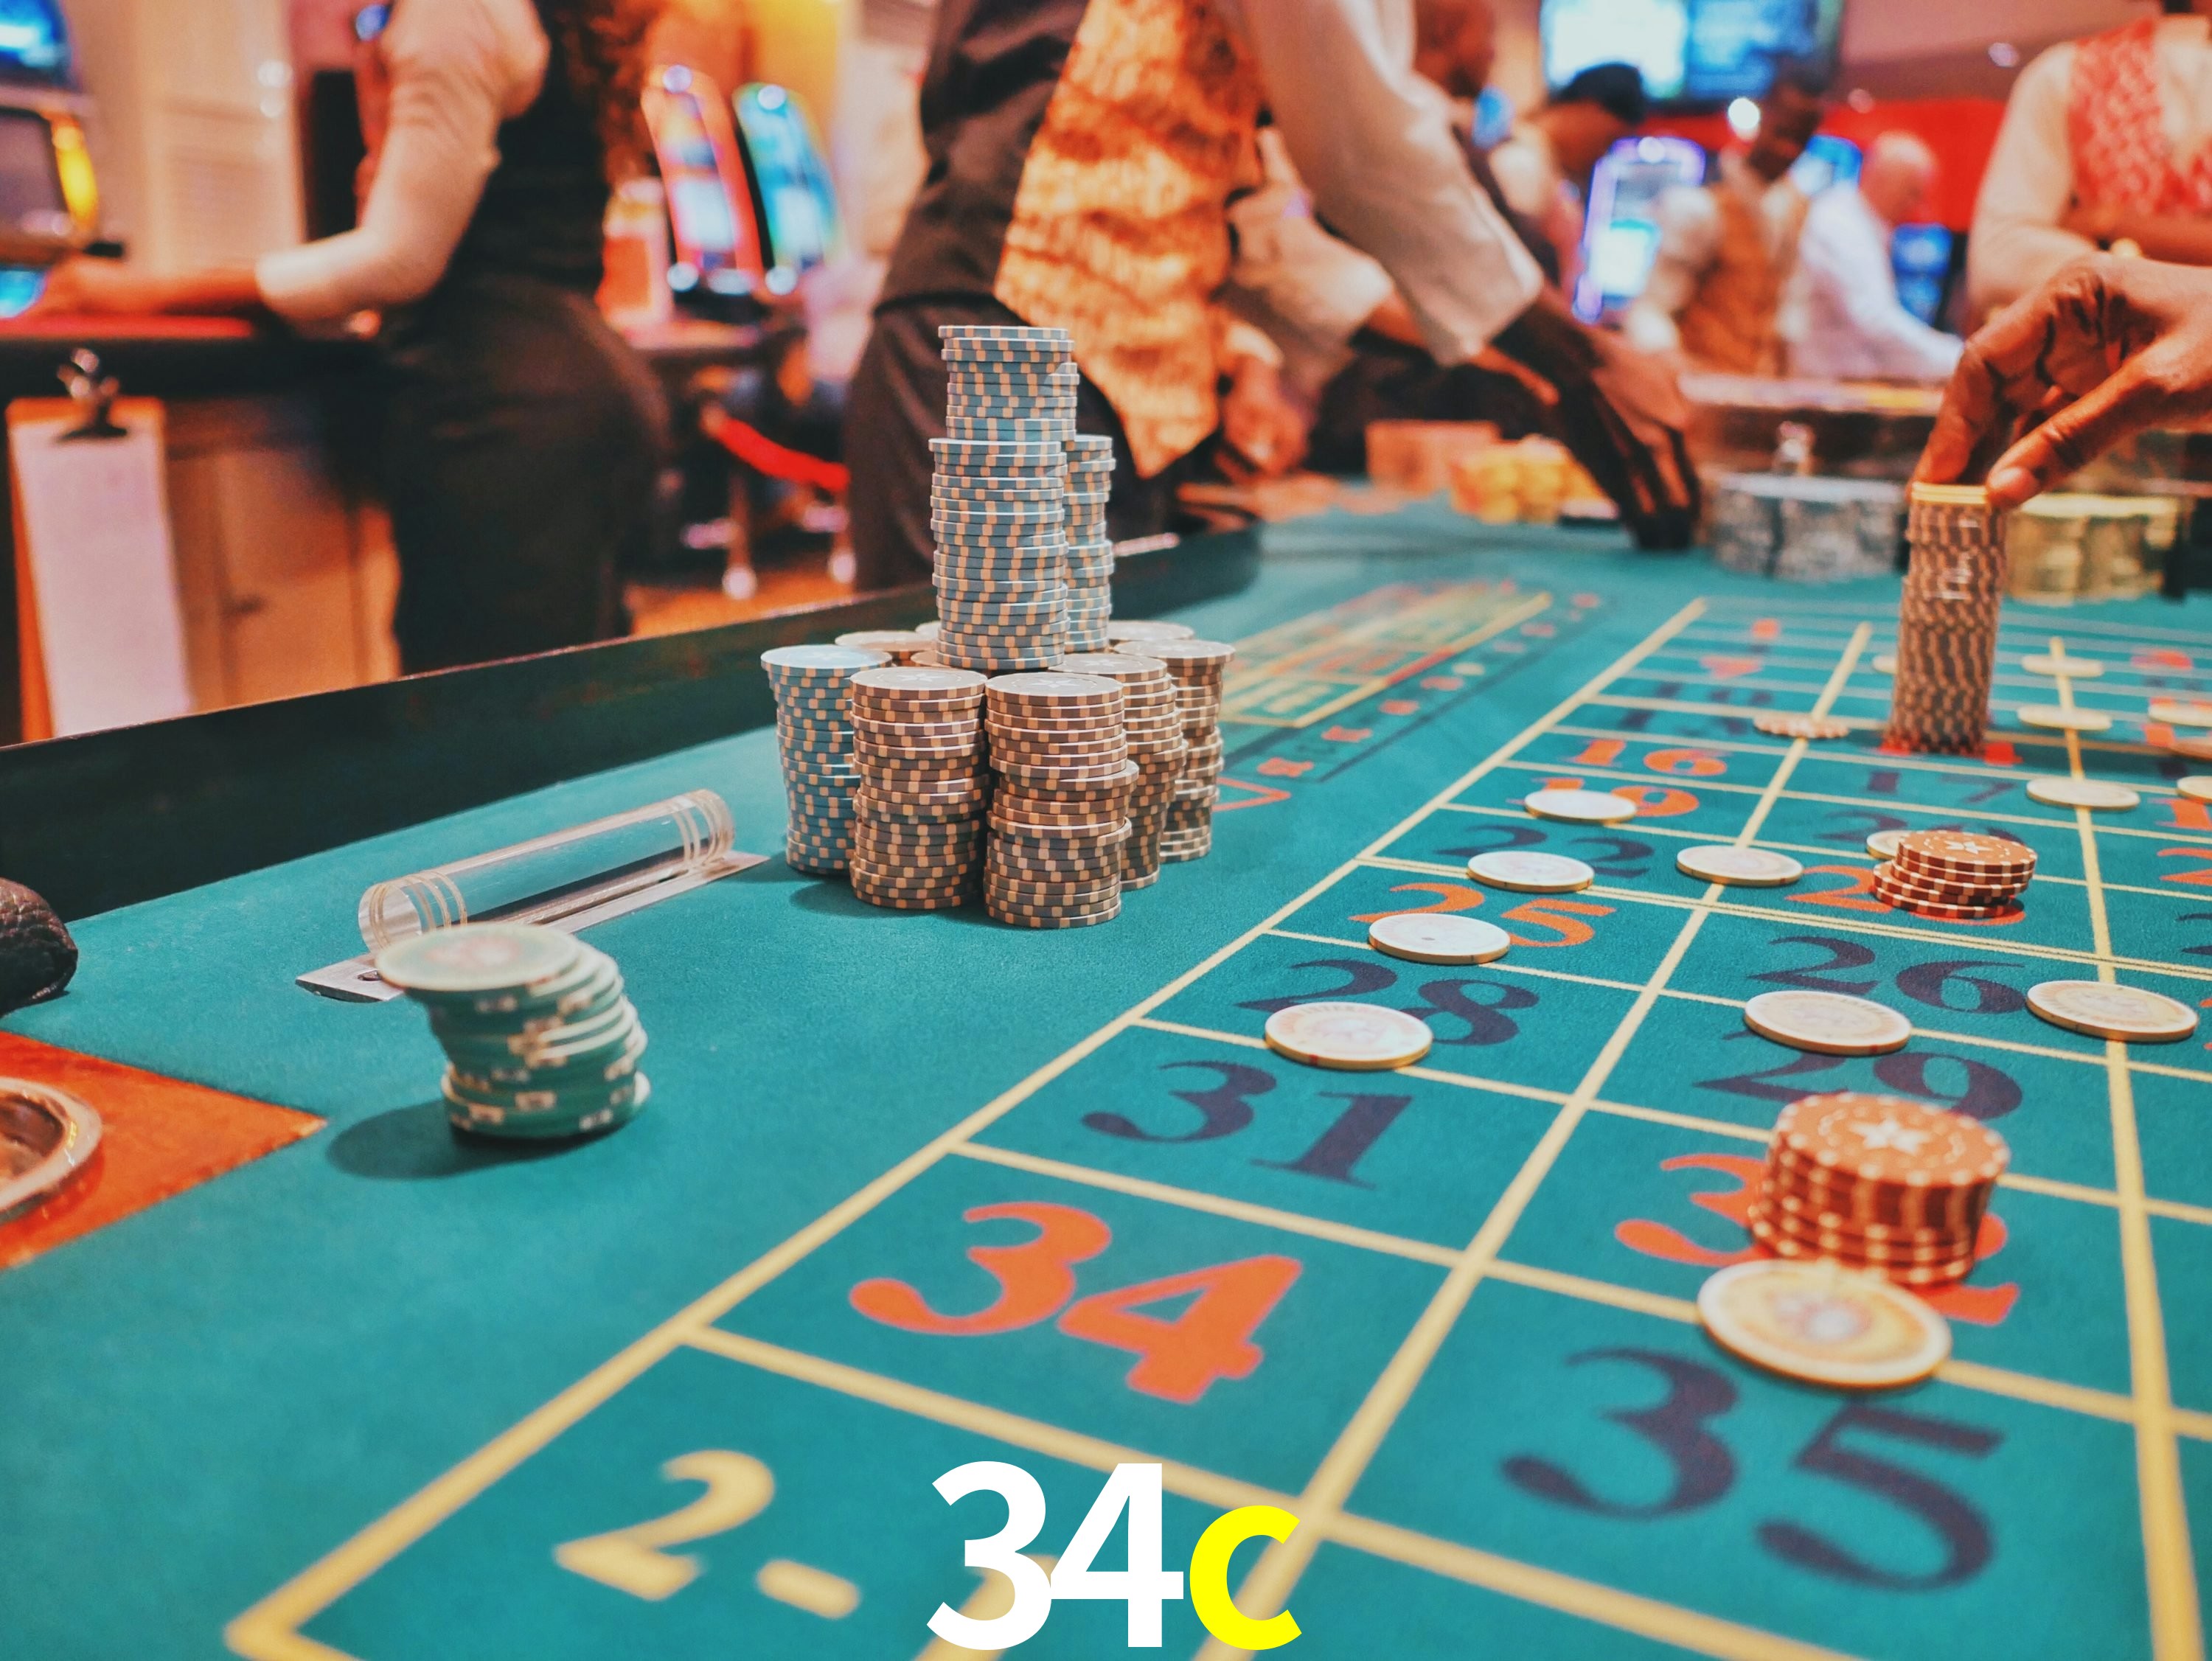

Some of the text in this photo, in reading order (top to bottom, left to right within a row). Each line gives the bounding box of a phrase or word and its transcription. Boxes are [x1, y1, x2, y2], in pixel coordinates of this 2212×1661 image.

[1557, 738, 1731, 776] 16
[1861, 769, 2017, 804] 17
[1433, 823, 1654, 879] 22
[1348, 882, 1616, 947] 25
[1784, 864, 2025, 927] 2
[1234, 959, 1540, 1046] 28
[1747, 936, 2028, 1014] 26
[1691, 1028, 2023, 1121] 29
[1079, 1060, 1414, 1191] 31
[849, 1200, 1303, 1405] 34
[1498, 1347, 2004, 1593] 35
